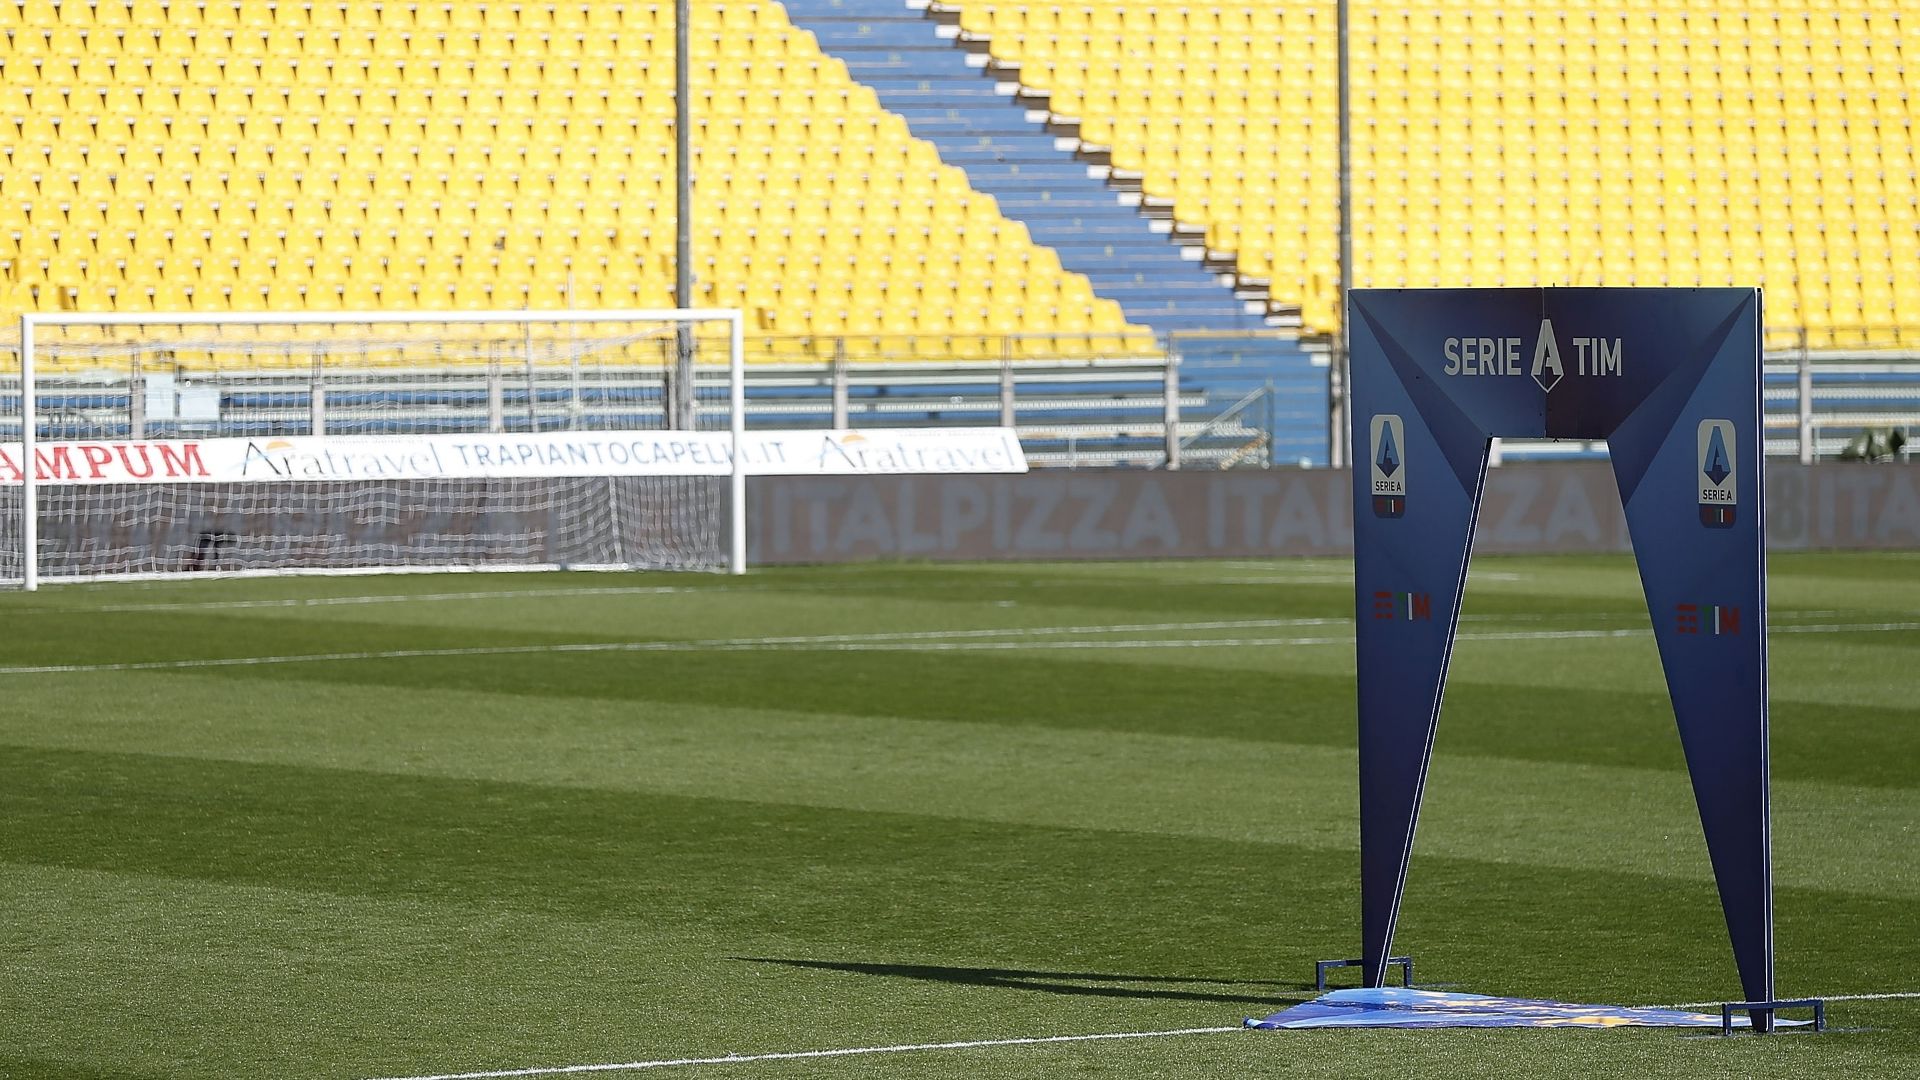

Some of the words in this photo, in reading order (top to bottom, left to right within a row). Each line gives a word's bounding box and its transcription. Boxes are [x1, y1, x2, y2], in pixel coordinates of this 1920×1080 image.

[1443, 337, 1522, 376] SERIE
[1531, 319, 1565, 393] A
[1572, 337, 1622, 377] TIM
[241, 440, 446, 478] Aratravel
[819, 435, 1016, 470] Aratravel
[1375, 481, 1395, 492] SERIE
[1703, 489, 1725, 501] SERIE
[1727, 490, 1733, 501] A
[771, 478, 1180, 553] ITALPIZZA
[1702, 605, 1741, 636] TIM
